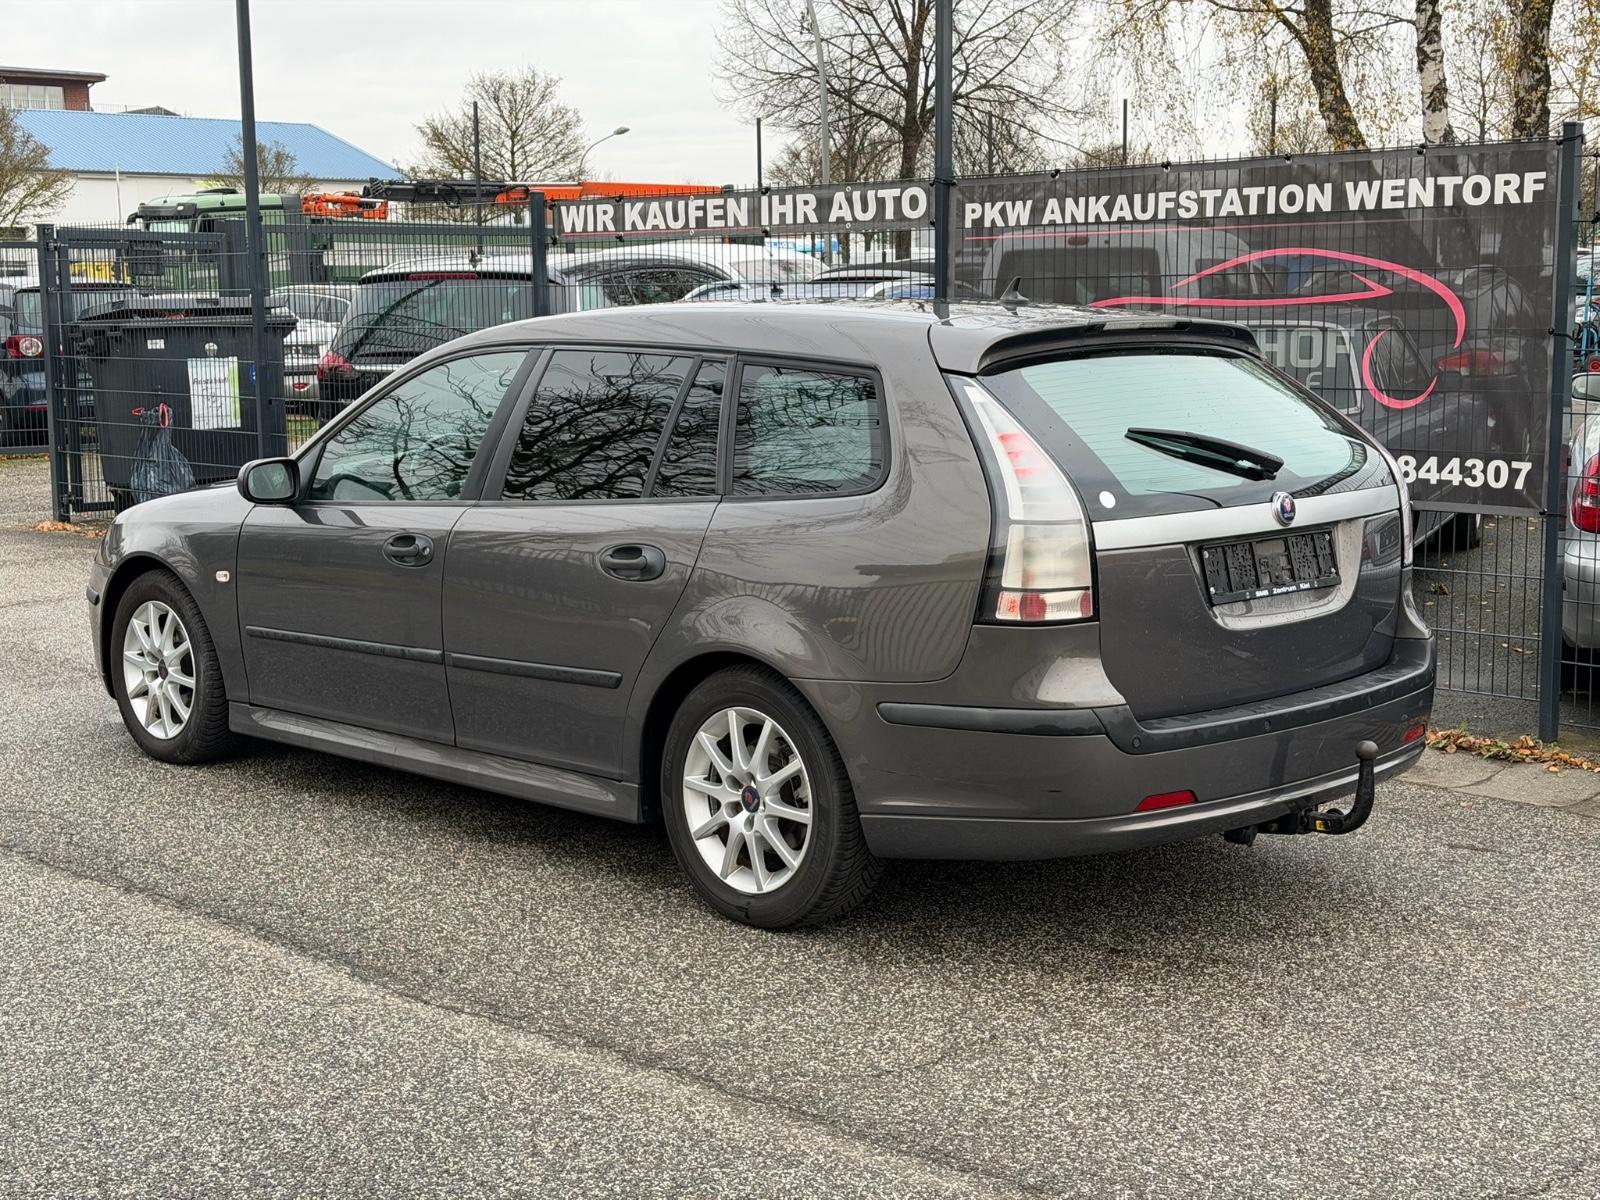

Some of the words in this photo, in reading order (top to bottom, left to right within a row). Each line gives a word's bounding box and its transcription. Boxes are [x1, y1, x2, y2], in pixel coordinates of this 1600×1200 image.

[560, 203, 616, 233] WIR
[624, 196, 748, 231] KAUFEN
[760, 193, 819, 226] IHR
[828, 186, 928, 223] AUTO
[964, 200, 1033, 229] PKW
[1041, 183, 1333, 226] ANKAUFSTATION
[1346, 170, 1547, 212] WENTORF
[1396, 455, 1533, 490] 844307
